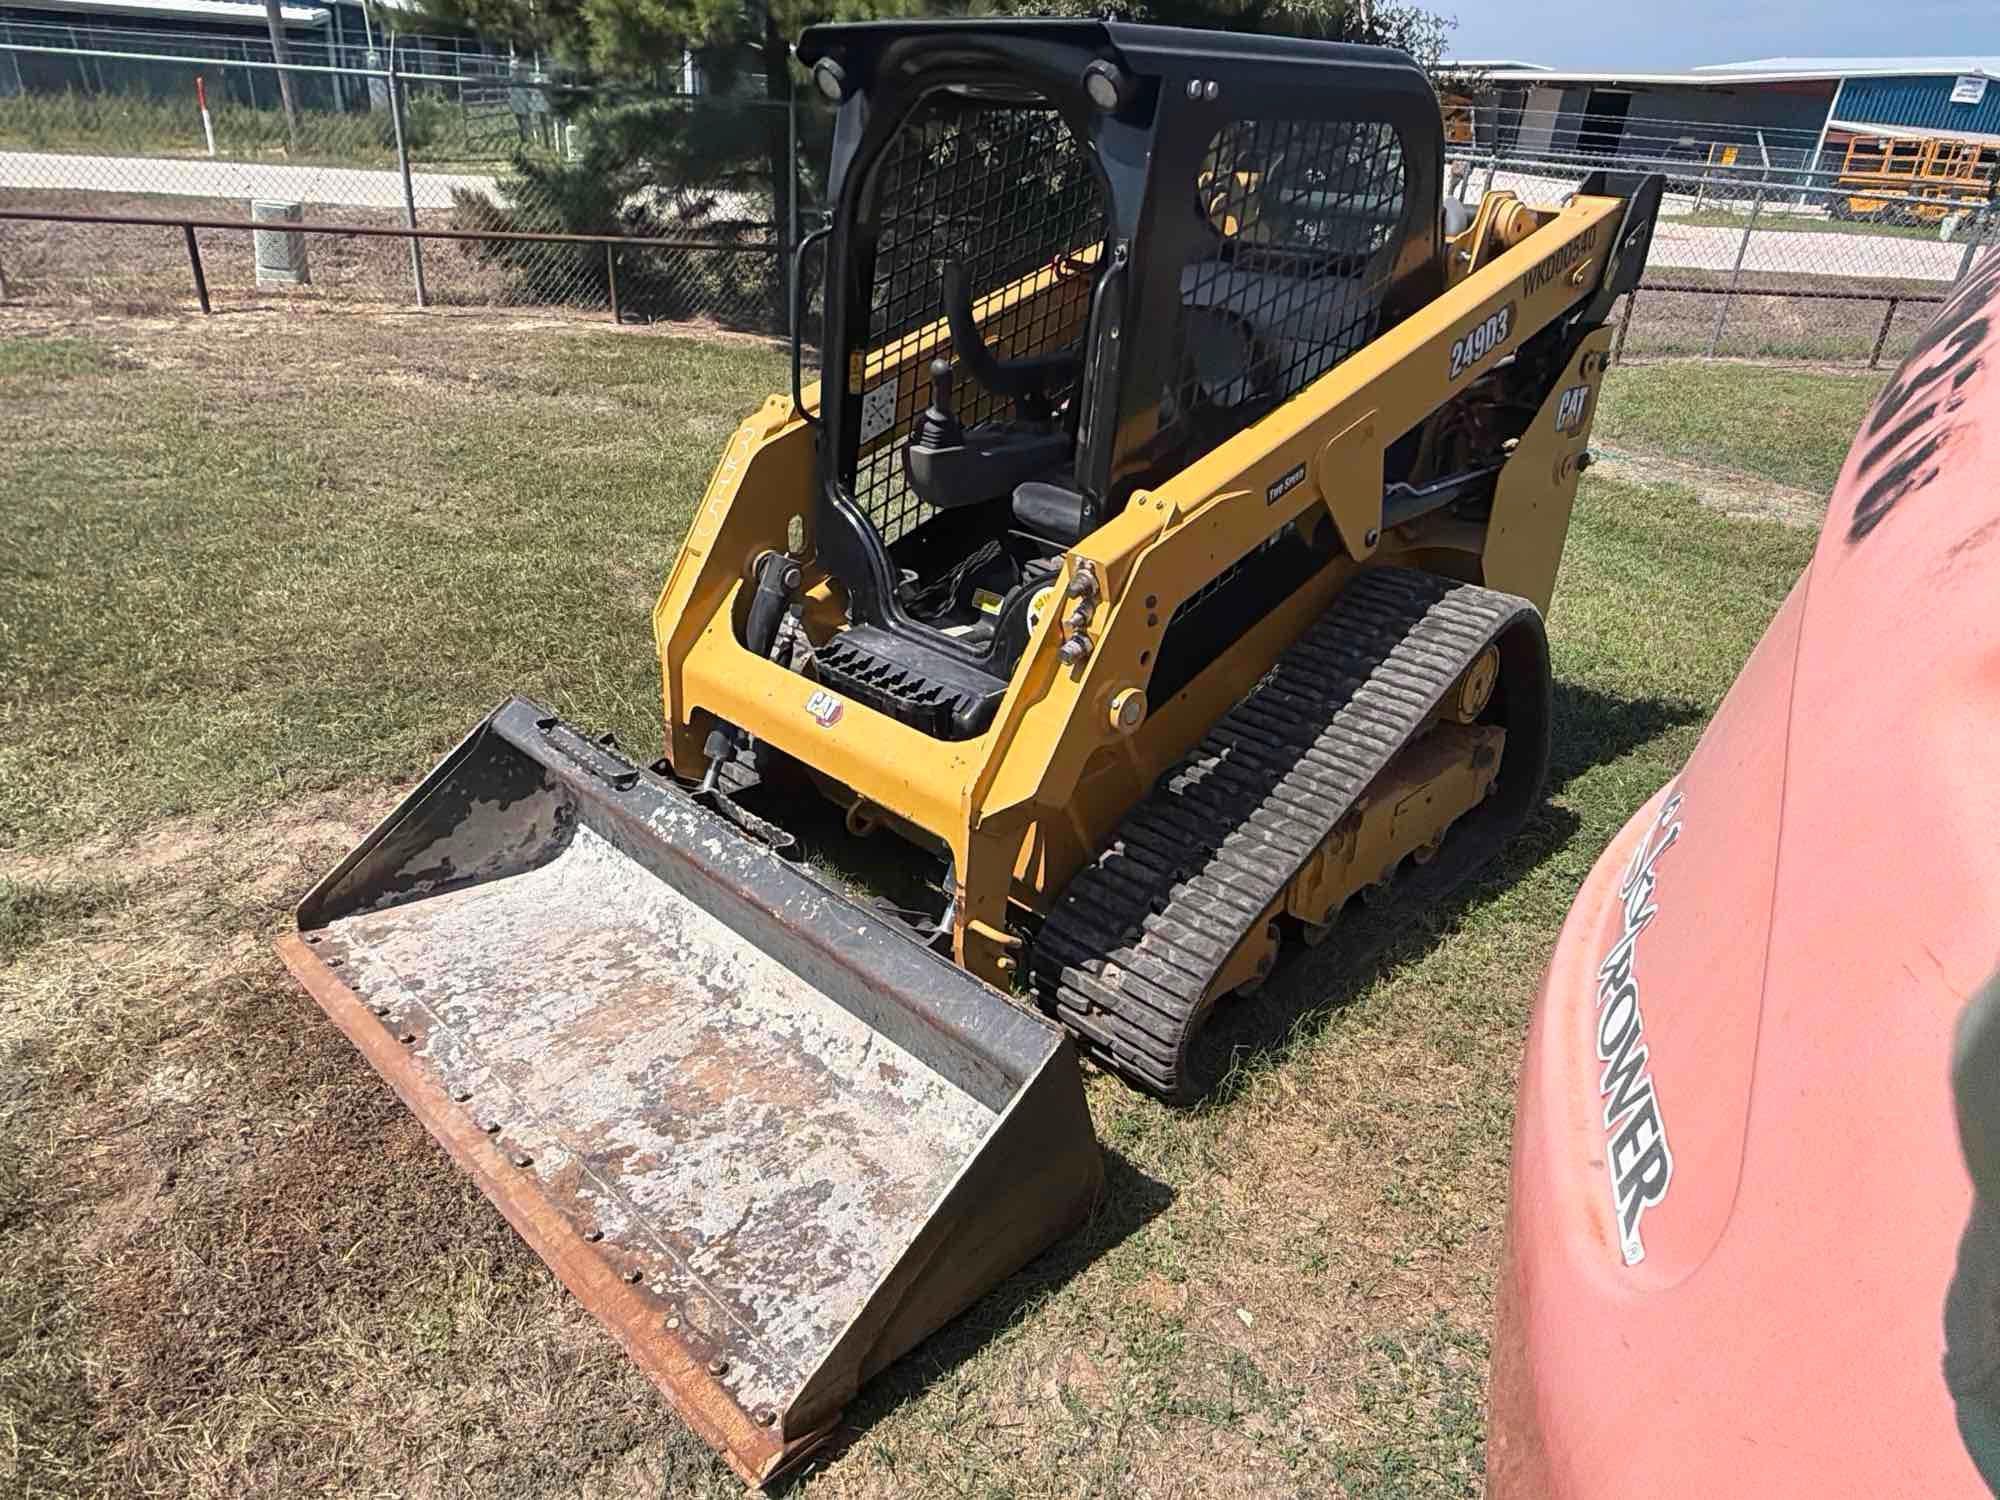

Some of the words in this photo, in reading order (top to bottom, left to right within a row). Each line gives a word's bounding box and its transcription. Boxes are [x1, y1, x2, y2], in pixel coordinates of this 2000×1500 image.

[1451, 307, 1510, 380] 249D3
[1556, 387, 1590, 432] CAT
[805, 690, 842, 721] CAT
